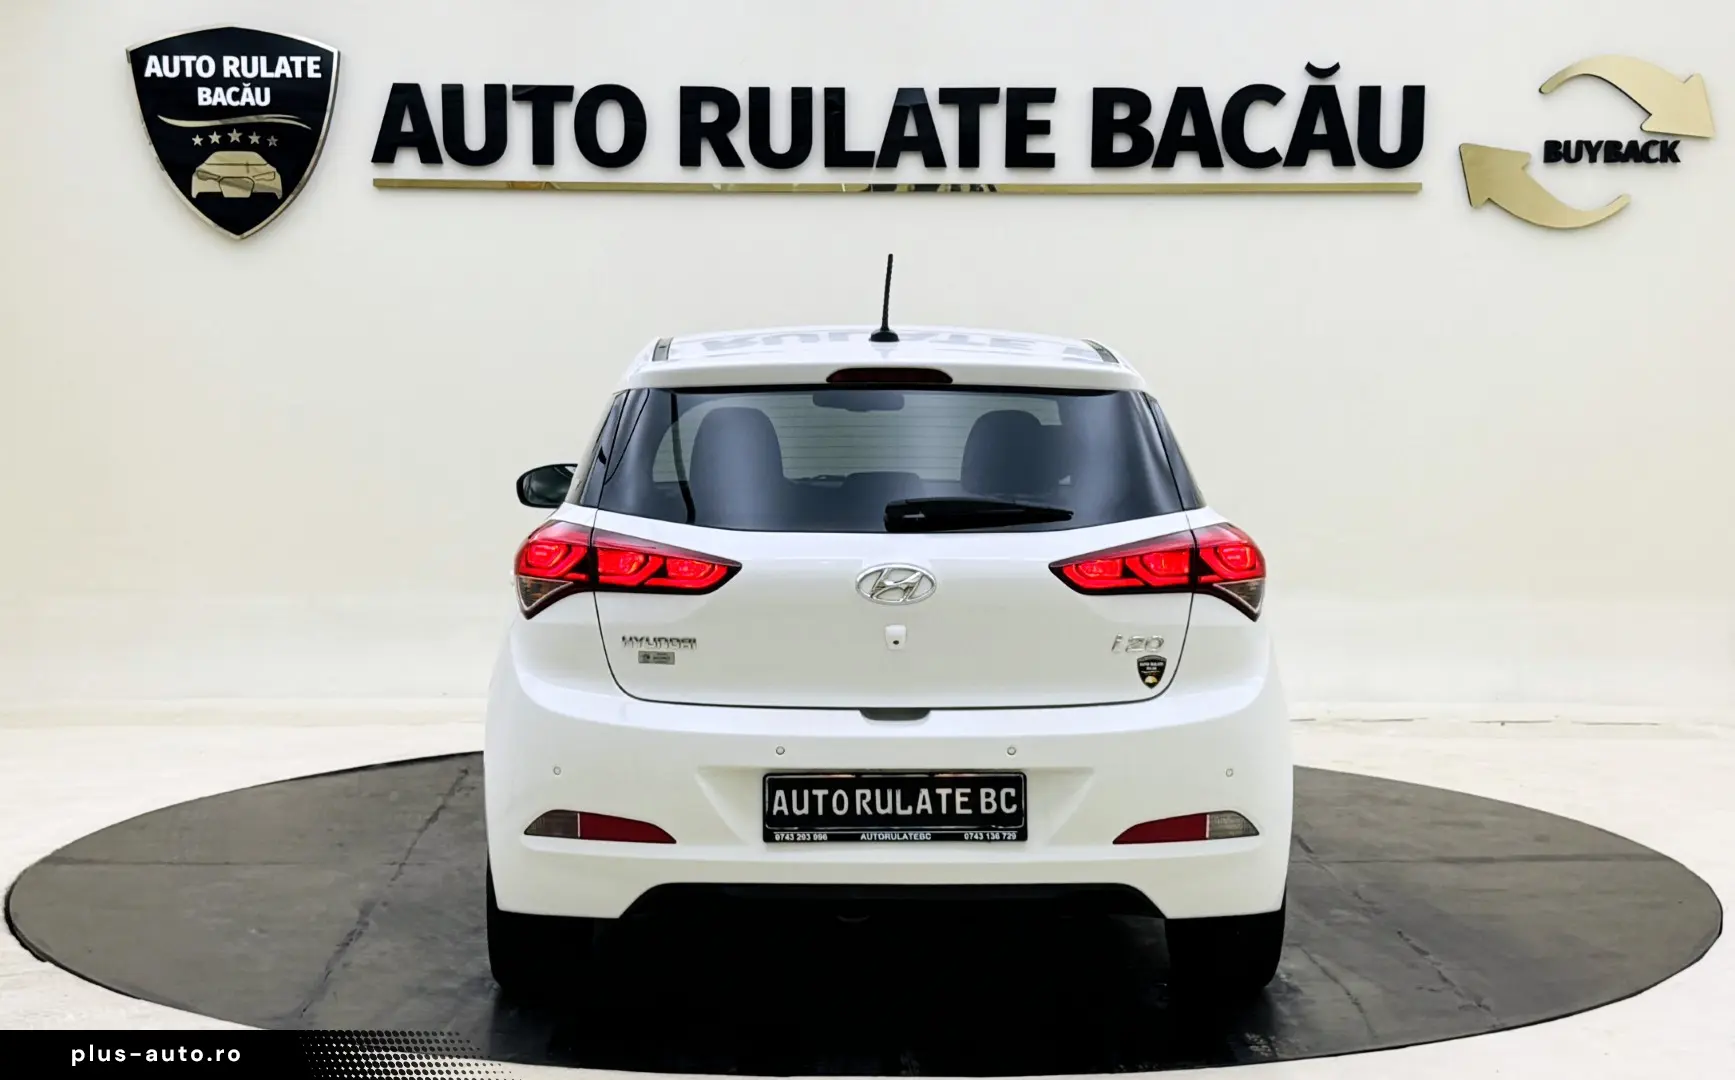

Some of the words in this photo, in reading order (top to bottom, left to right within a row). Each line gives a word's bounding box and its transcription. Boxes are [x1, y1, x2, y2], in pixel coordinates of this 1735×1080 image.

[145, 55, 215, 78] AUTO
[223, 56, 321, 78] RULATE
[198, 83, 270, 106] BACĂU
[371, 83, 647, 169] AUTO
[680, 86, 1056, 170] RULATE
[1091, 62, 1425, 169] BACĂU
[1543, 139, 1681, 164] BUYBACK
[773, 789, 848, 815] AUTO
[856, 788, 972, 815] RULATE
[980, 788, 1017, 813] BC
[860, 833, 932, 841] AUTORULATEBC
